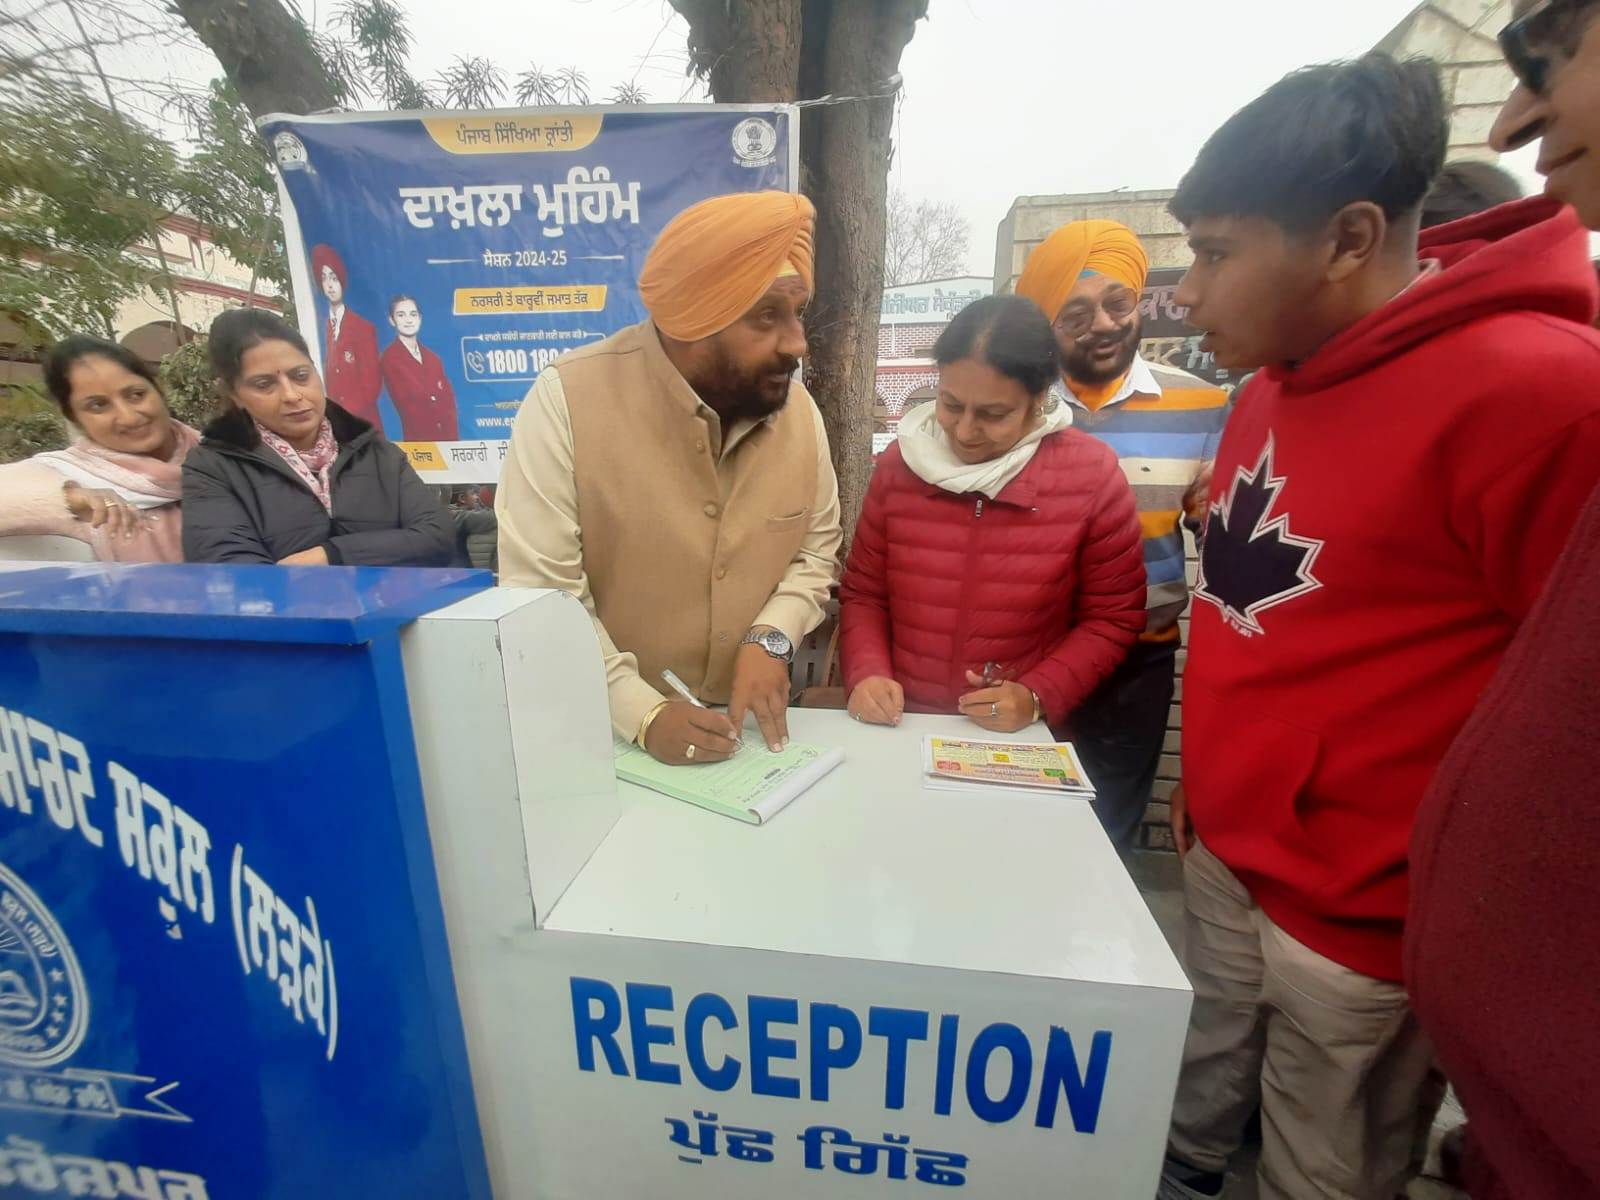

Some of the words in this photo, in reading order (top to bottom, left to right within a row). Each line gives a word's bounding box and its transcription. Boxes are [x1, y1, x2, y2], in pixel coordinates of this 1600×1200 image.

[456, 123, 491, 144] ਪੰਜਾਬ
[495, 121, 540, 144] ਸਿੱਖਿਆ
[544, 120, 573, 147] ਕ੍ਰਾਂਤੀ
[533, 166, 640, 237] ਮੁਹਿੰਮ
[515, 250, 567, 266] 2024-25
[470, 291, 503, 307] ਨਰਸਰੀ
[547, 293, 571, 305] ਜਮਾਤ
[573, 290, 589, 304] ਤੱਕ
[486, 349, 528, 374] 1800
[451, 441, 488, 462] ਸਰਕਾਰੀ
[108, 761, 216, 940] ਸਕੂਲ
[230, 842, 339, 1062] (ਲੜਕੇ)
[569, 976, 1112, 1135] RECEPTION
[664, 1110, 776, 1166] ਪੁੱਛ
[796, 1126, 970, 1187] ਗਿੱਛ
